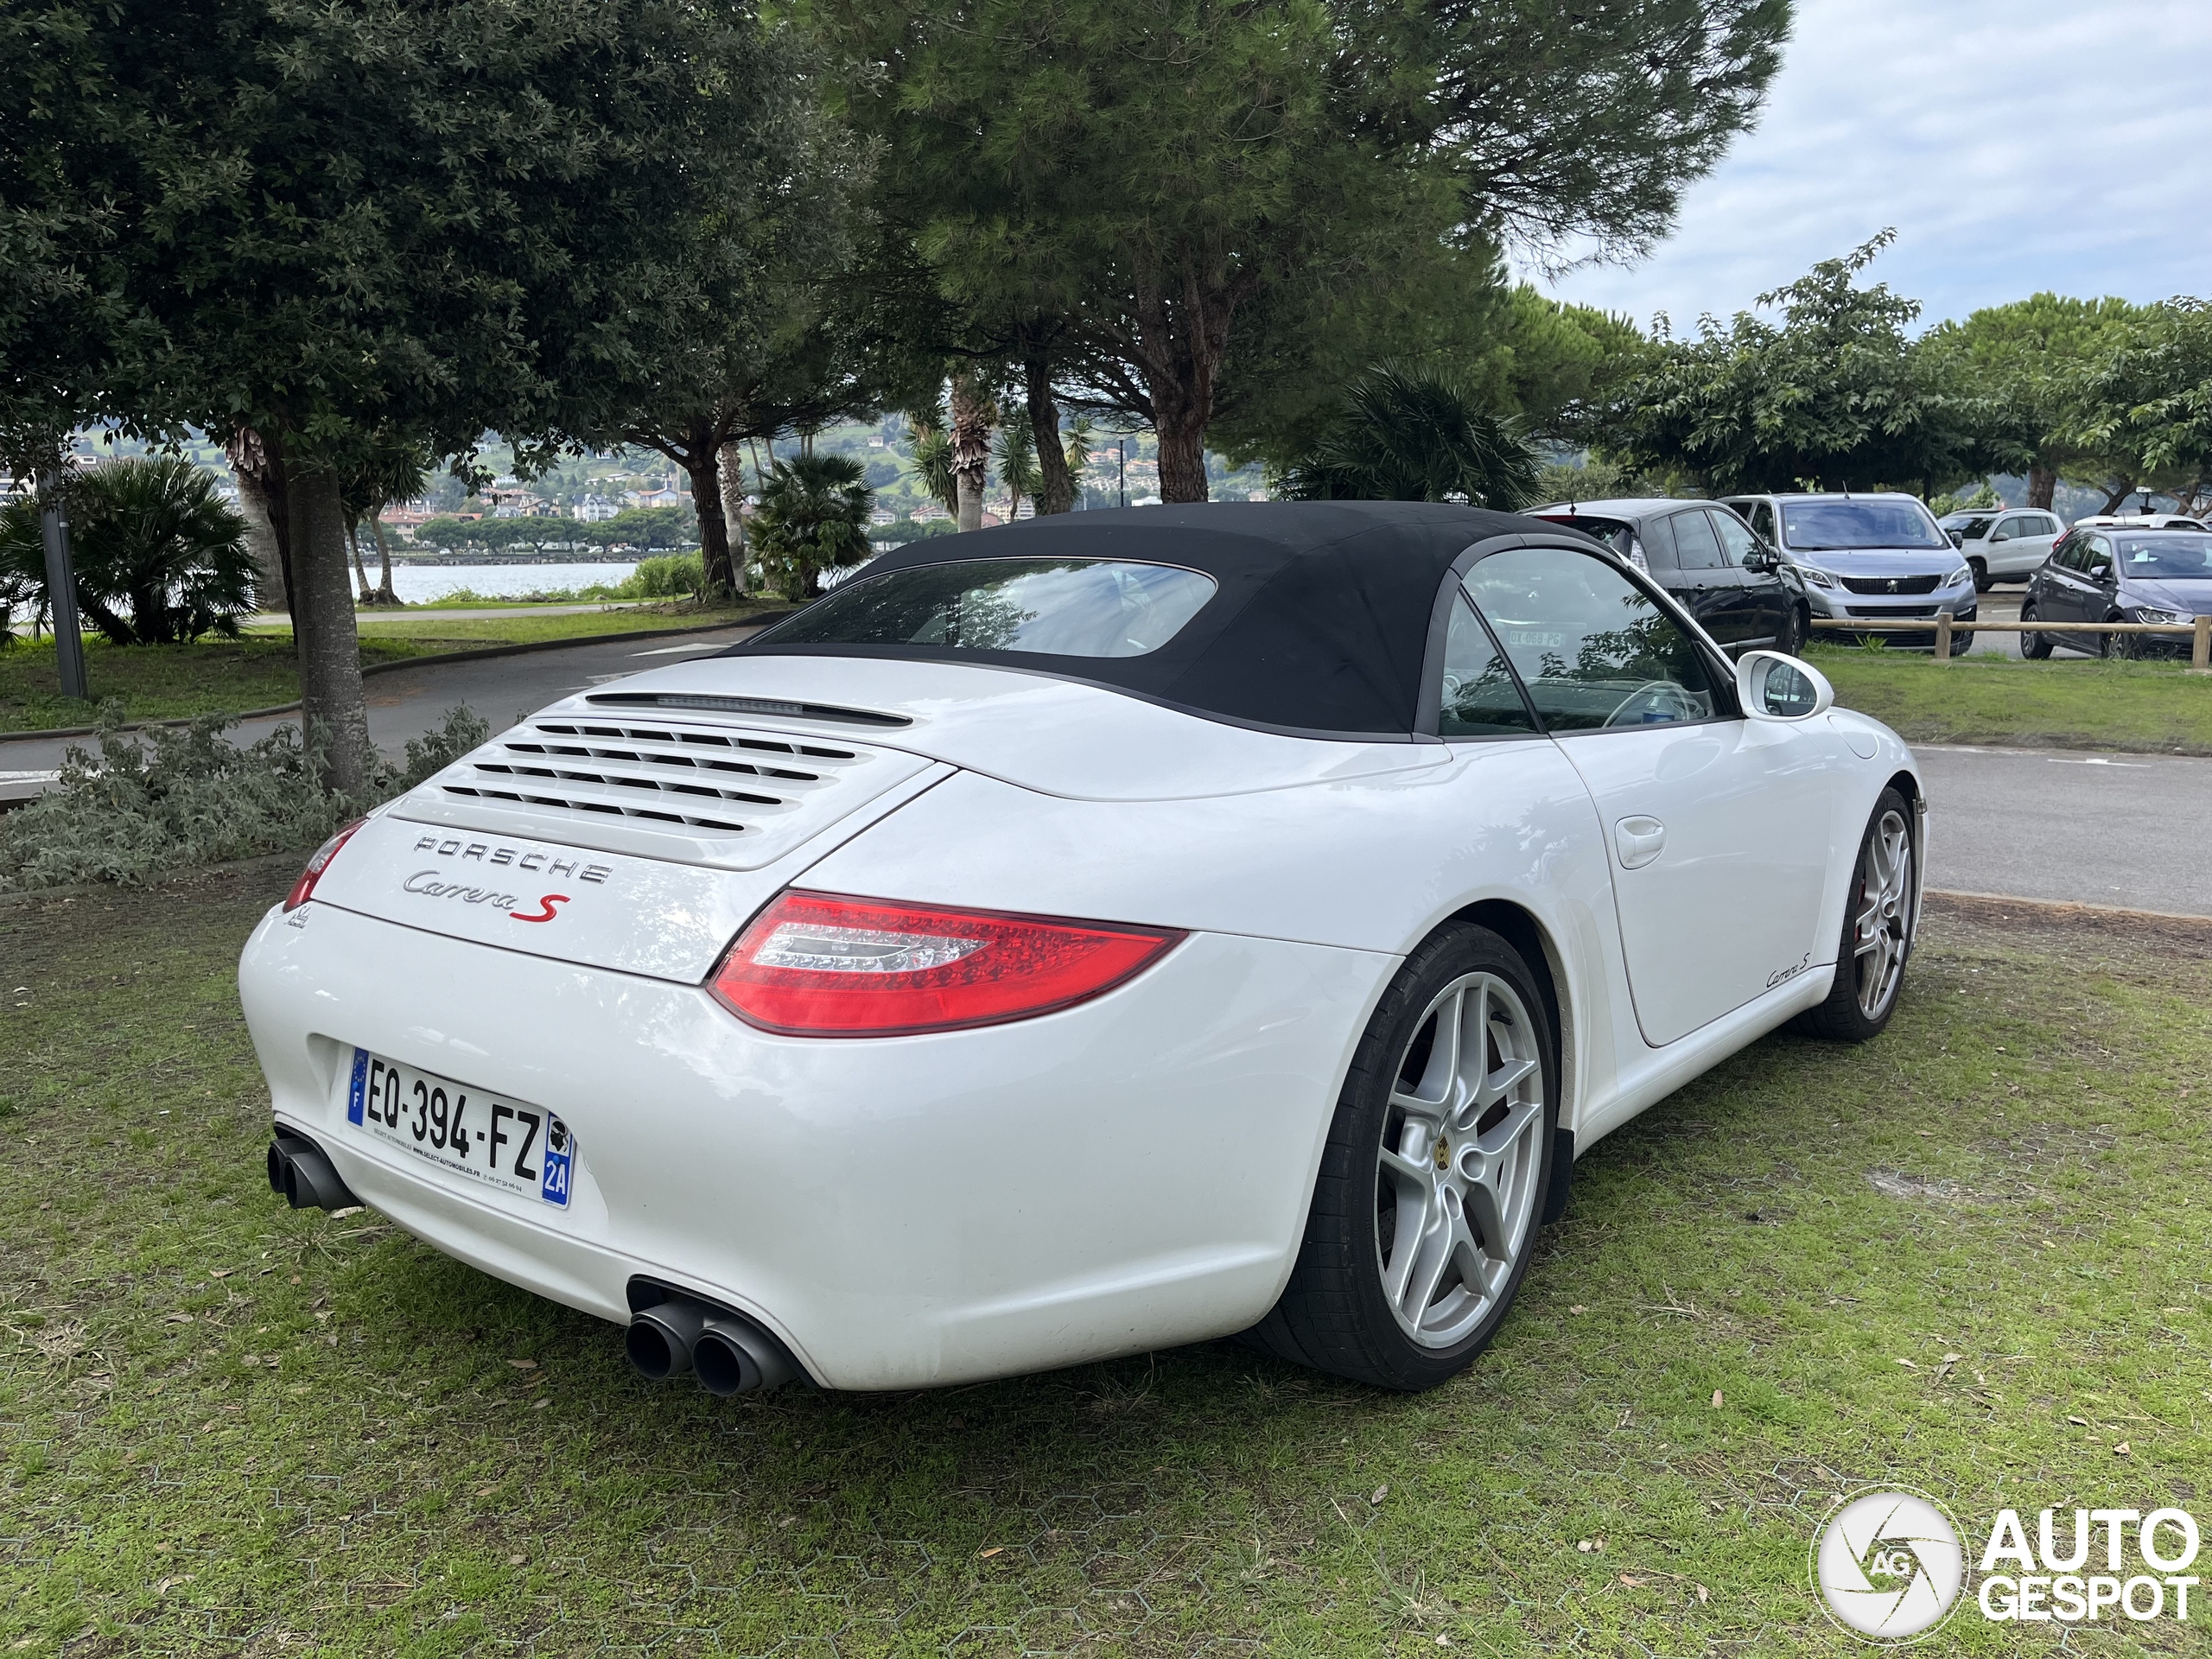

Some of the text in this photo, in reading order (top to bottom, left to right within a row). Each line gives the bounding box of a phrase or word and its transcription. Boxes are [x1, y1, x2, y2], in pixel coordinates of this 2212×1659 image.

[414, 836, 613, 884] PORSCHE
[403, 869, 571, 923] Carrera S
[1766, 952, 1810, 988] Carrera S
[353, 1091, 359, 1108] F
[367, 1058, 540, 1181] EQ-394-FZ
[544, 1160, 566, 1195] 2A
